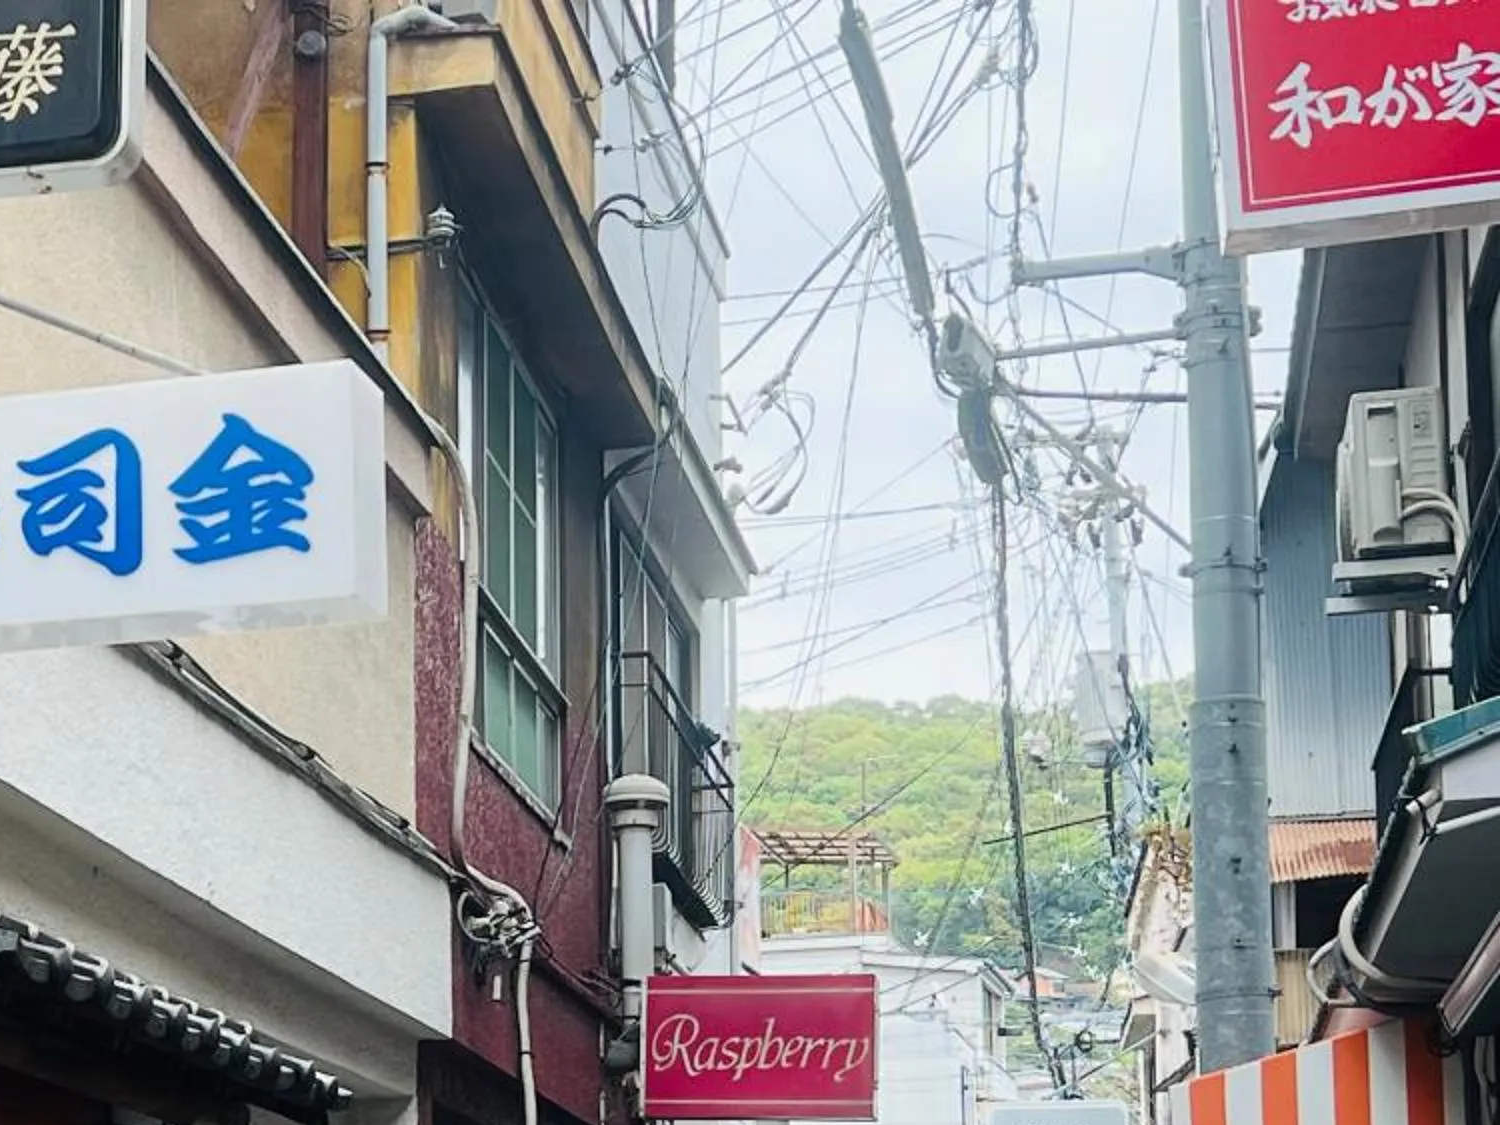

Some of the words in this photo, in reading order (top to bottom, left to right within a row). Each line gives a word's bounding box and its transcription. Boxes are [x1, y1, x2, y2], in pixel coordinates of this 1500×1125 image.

[1267, 42, 1500, 148] 和が家
[651, 1013, 869, 1083] Raspberry
